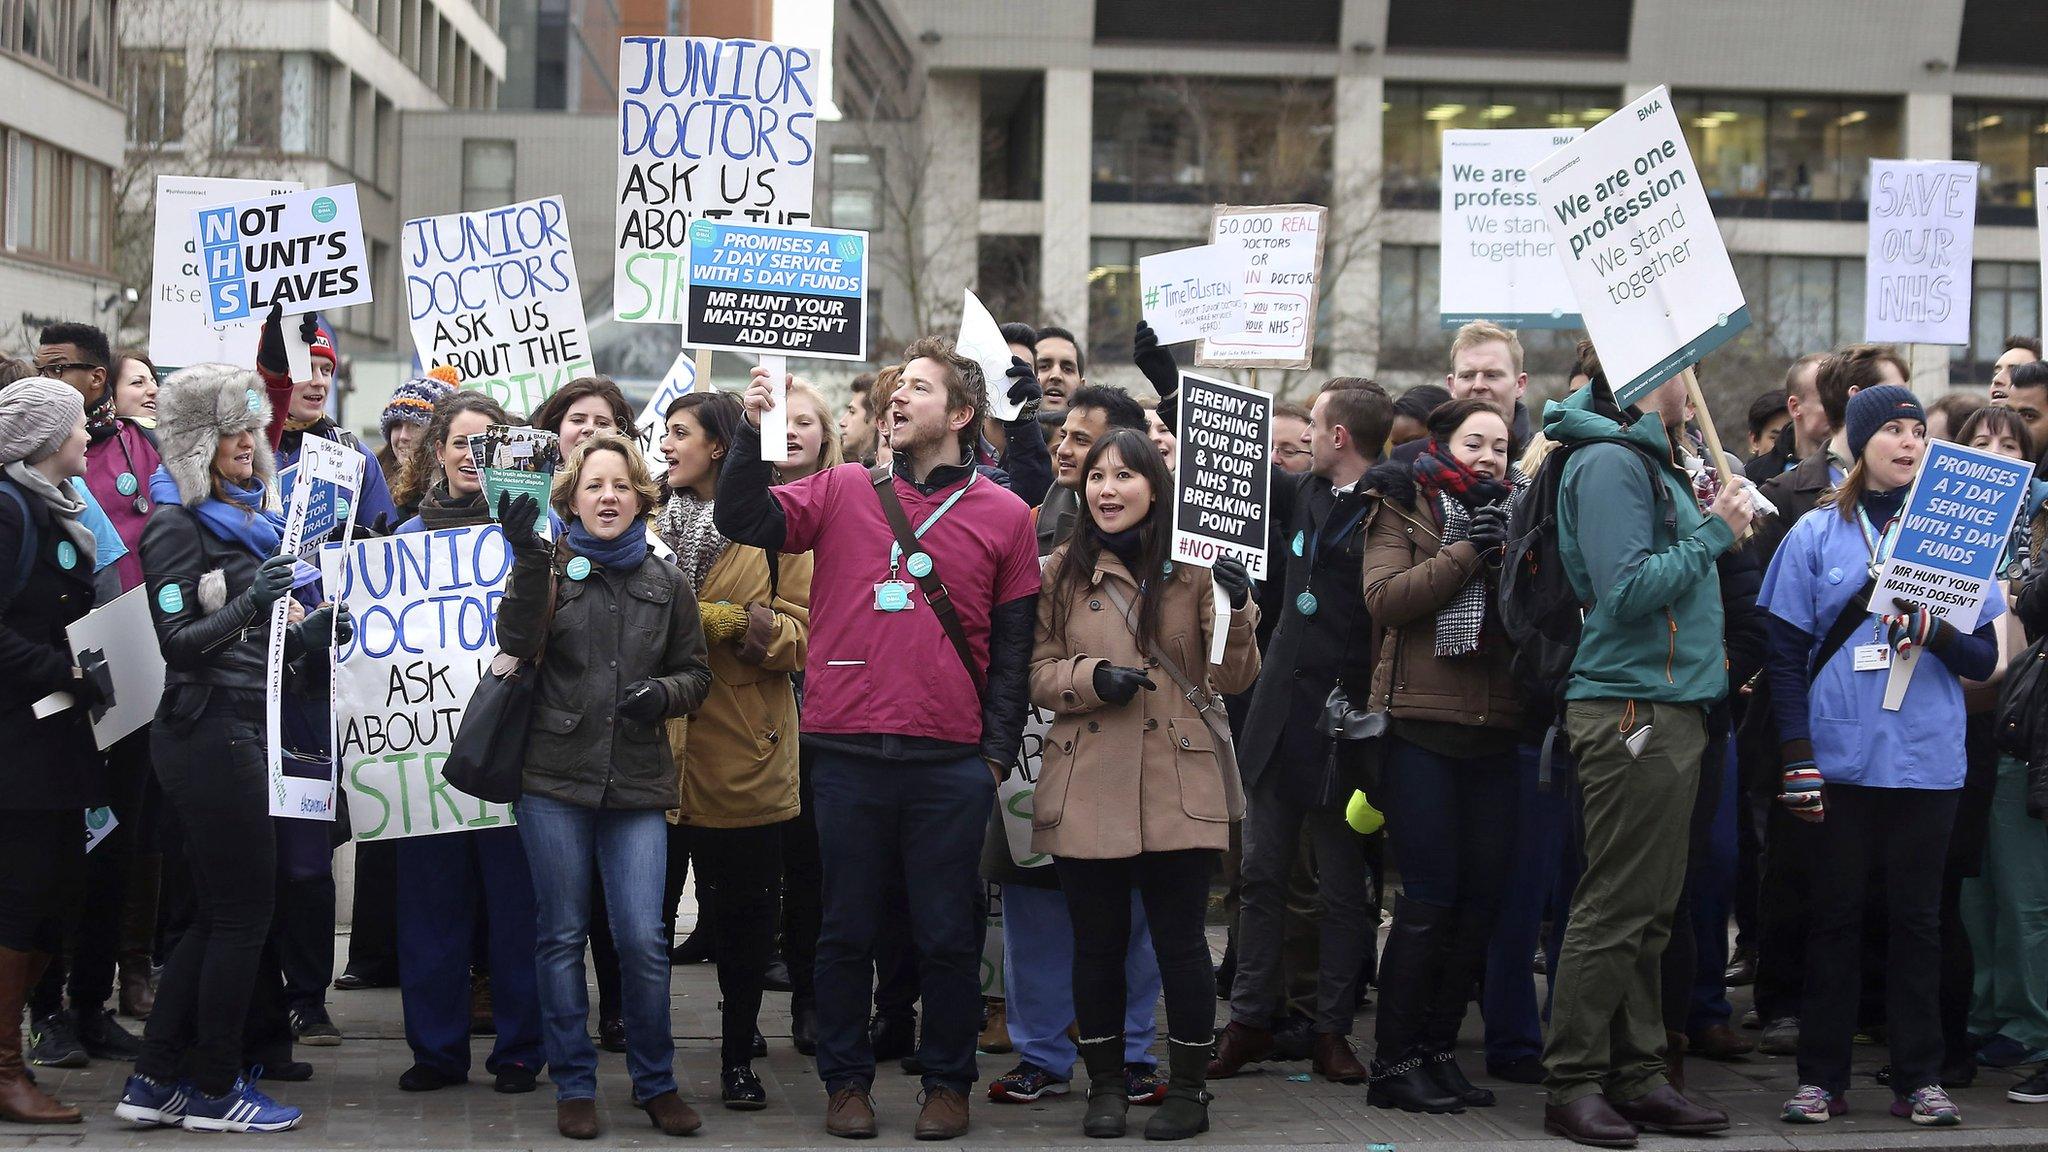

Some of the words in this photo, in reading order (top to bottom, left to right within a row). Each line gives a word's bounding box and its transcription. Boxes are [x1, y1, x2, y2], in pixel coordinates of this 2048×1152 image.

[624, 37, 813, 106] JUNIOR
[1636, 100, 1663, 122] BMA
[622, 100, 814, 165] DOCTORS
[620, 162, 700, 205] ASK
[720, 164, 776, 207] US
[1452, 164, 1485, 182] We
[1491, 168, 1527, 182] are
[1553, 193, 1590, 226] We
[1595, 169, 1629, 200] are
[1634, 139, 1676, 176] one
[1454, 189, 1541, 210] profess
[1875, 171, 1973, 219] SAVE
[206, 204, 286, 244] NOT
[620, 208, 733, 250] ABO
[1282, 216, 1317, 232] REAL
[1467, 214, 1498, 233] We
[1568, 167, 1687, 260] profession
[406, 200, 567, 268] JUNIOR
[723, 233, 814, 254] PROMISES
[815, 240, 830, 255] A
[1470, 239, 1556, 262] together
[1591, 246, 1625, 278] We
[1630, 204, 1686, 255] stand
[1881, 228, 1955, 269] OUR
[211, 231, 347, 280] HUNT'S
[711, 249, 725, 264] 7
[726, 251, 768, 267] DAY
[769, 253, 845, 274] SERVICE
[1251, 253, 1268, 266] OR
[1607, 237, 1692, 305] together
[161, 283, 185, 303] It's
[218, 265, 359, 314] SLAVES
[408, 249, 570, 320] DOCTORS
[693, 265, 739, 282] WITH
[742, 269, 754, 283] 5
[757, 270, 798, 288] DAY
[800, 274, 860, 292] FUNDS
[707, 291, 738, 308] MR
[740, 293, 793, 312] HUNT
[794, 297, 844, 316] YOUR
[1253, 302, 1268, 312] YOU
[1273, 302, 1301, 311] TRUST
[1878, 274, 1952, 323] NHS
[433, 312, 494, 352] ASK
[510, 301, 550, 333] US
[702, 308, 767, 327] MATHS
[769, 313, 848, 333] DOESN'T
[1245, 320, 1263, 331] YOUR
[519, 329, 582, 367] THE
[735, 329, 778, 345] ADD
[782, 333, 813, 348] UP!
[1187, 386, 1248, 415] JEREMY
[1249, 402, 1264, 421] IS
[1191, 407, 1259, 439] PUSHING
[1187, 427, 1231, 452] YOUR
[1232, 438, 1264, 461] DRS
[1195, 449, 1207, 467] &
[1212, 453, 1254, 478] YOUR
[1933, 454, 2020, 488] PROMISES
[1196, 470, 1228, 492] NHS
[1232, 479, 1251, 497] TO
[1932, 477, 1949, 493] A
[1951, 481, 1966, 496] 7
[1964, 485, 2006, 506] DAY
[1183, 486, 1262, 521] BREAKING
[1926, 497, 1998, 527] SERVICE
[1199, 511, 1246, 537] POINT
[1905, 514, 1951, 537] WITH
[1950, 526, 1962, 540] 5
[1965, 529, 2004, 550] DAY
[323, 525, 516, 600] JUNIO
[1916, 539, 1976, 566] FUNDS
[1883, 578, 1925, 596] MATHS
[1926, 587, 1978, 609] DOESN'T
[1891, 564, 1912, 579] MR
[1913, 569, 1947, 586] HUNT
[1948, 577, 1980, 594] YOUR
[1929, 605, 1950, 618] UP!
[386, 660, 456, 708] ASK
[341, 707, 462, 757] ABOUT
